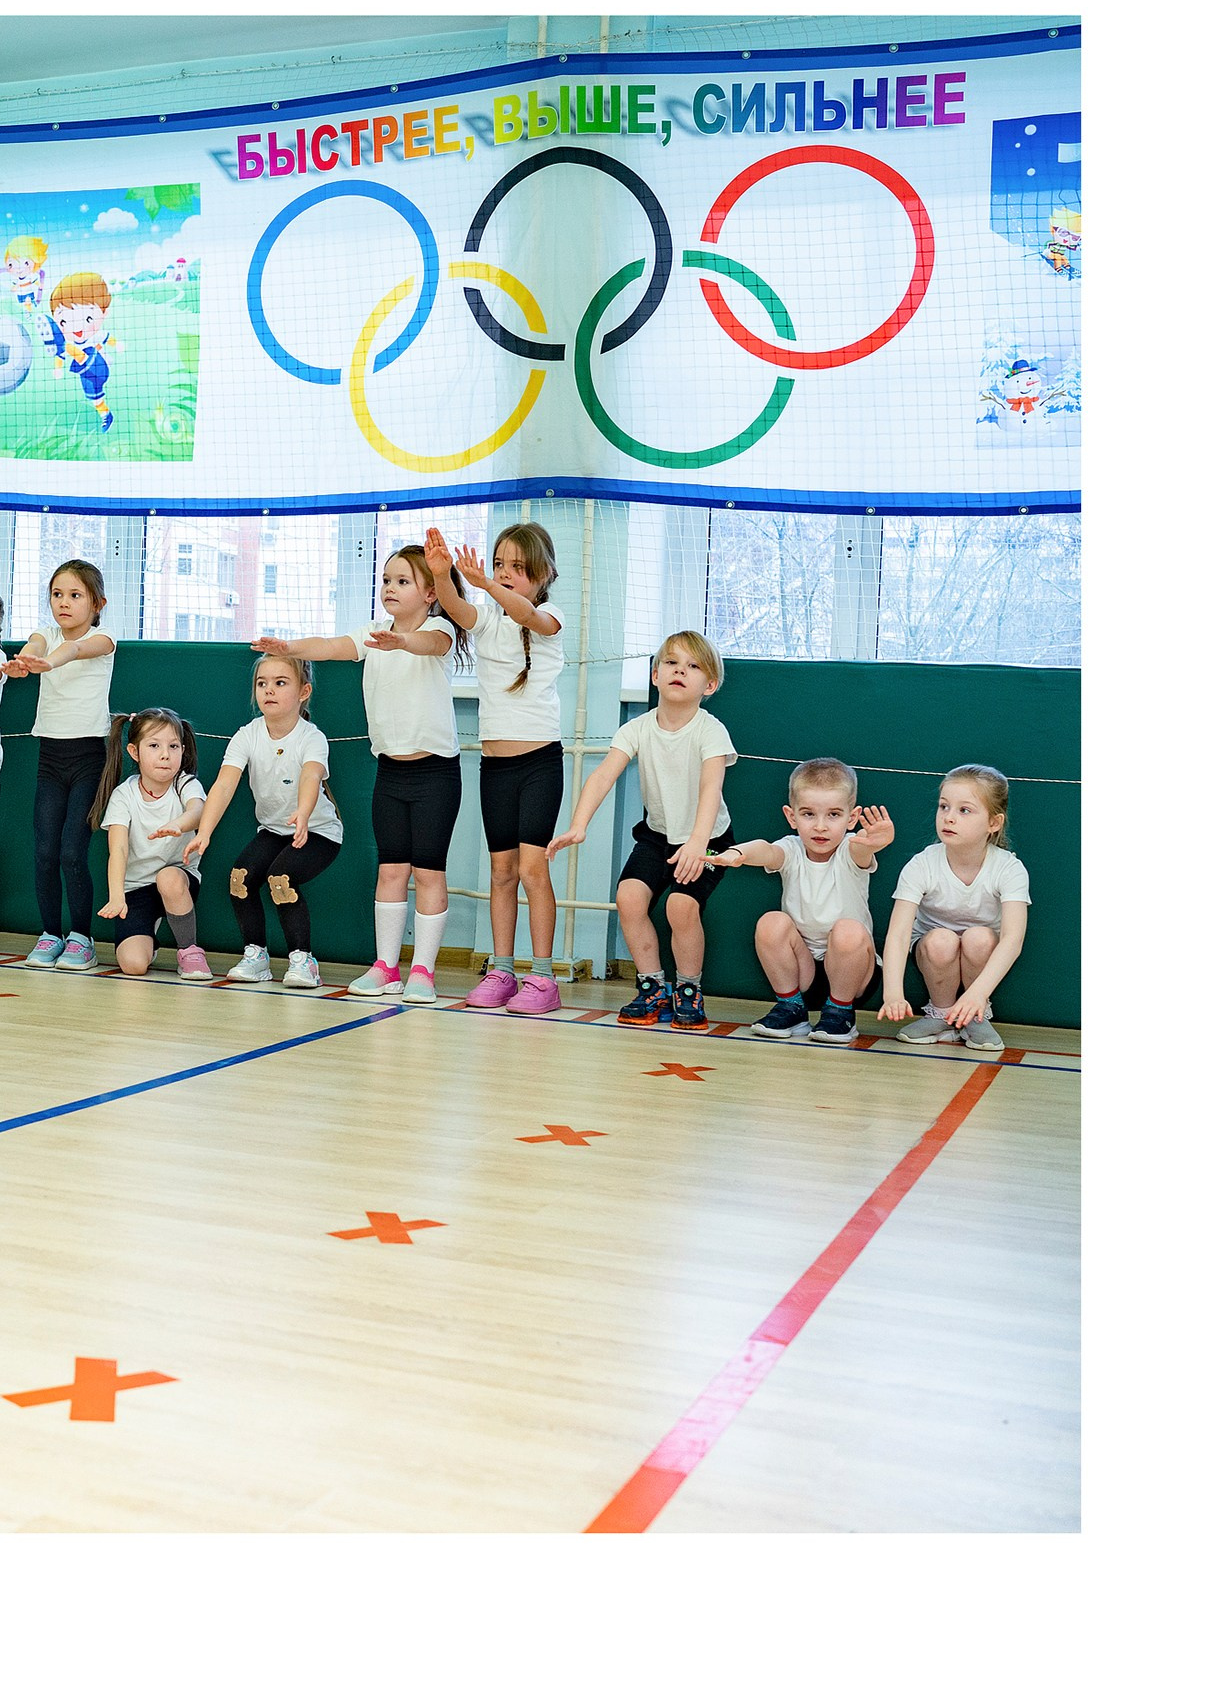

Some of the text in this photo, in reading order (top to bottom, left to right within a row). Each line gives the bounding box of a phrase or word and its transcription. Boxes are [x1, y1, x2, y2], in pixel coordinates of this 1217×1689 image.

[237, 72, 967, 180] БЫСТРЕЕ, ВЫШЕ, СИЛЬНЕЕ
